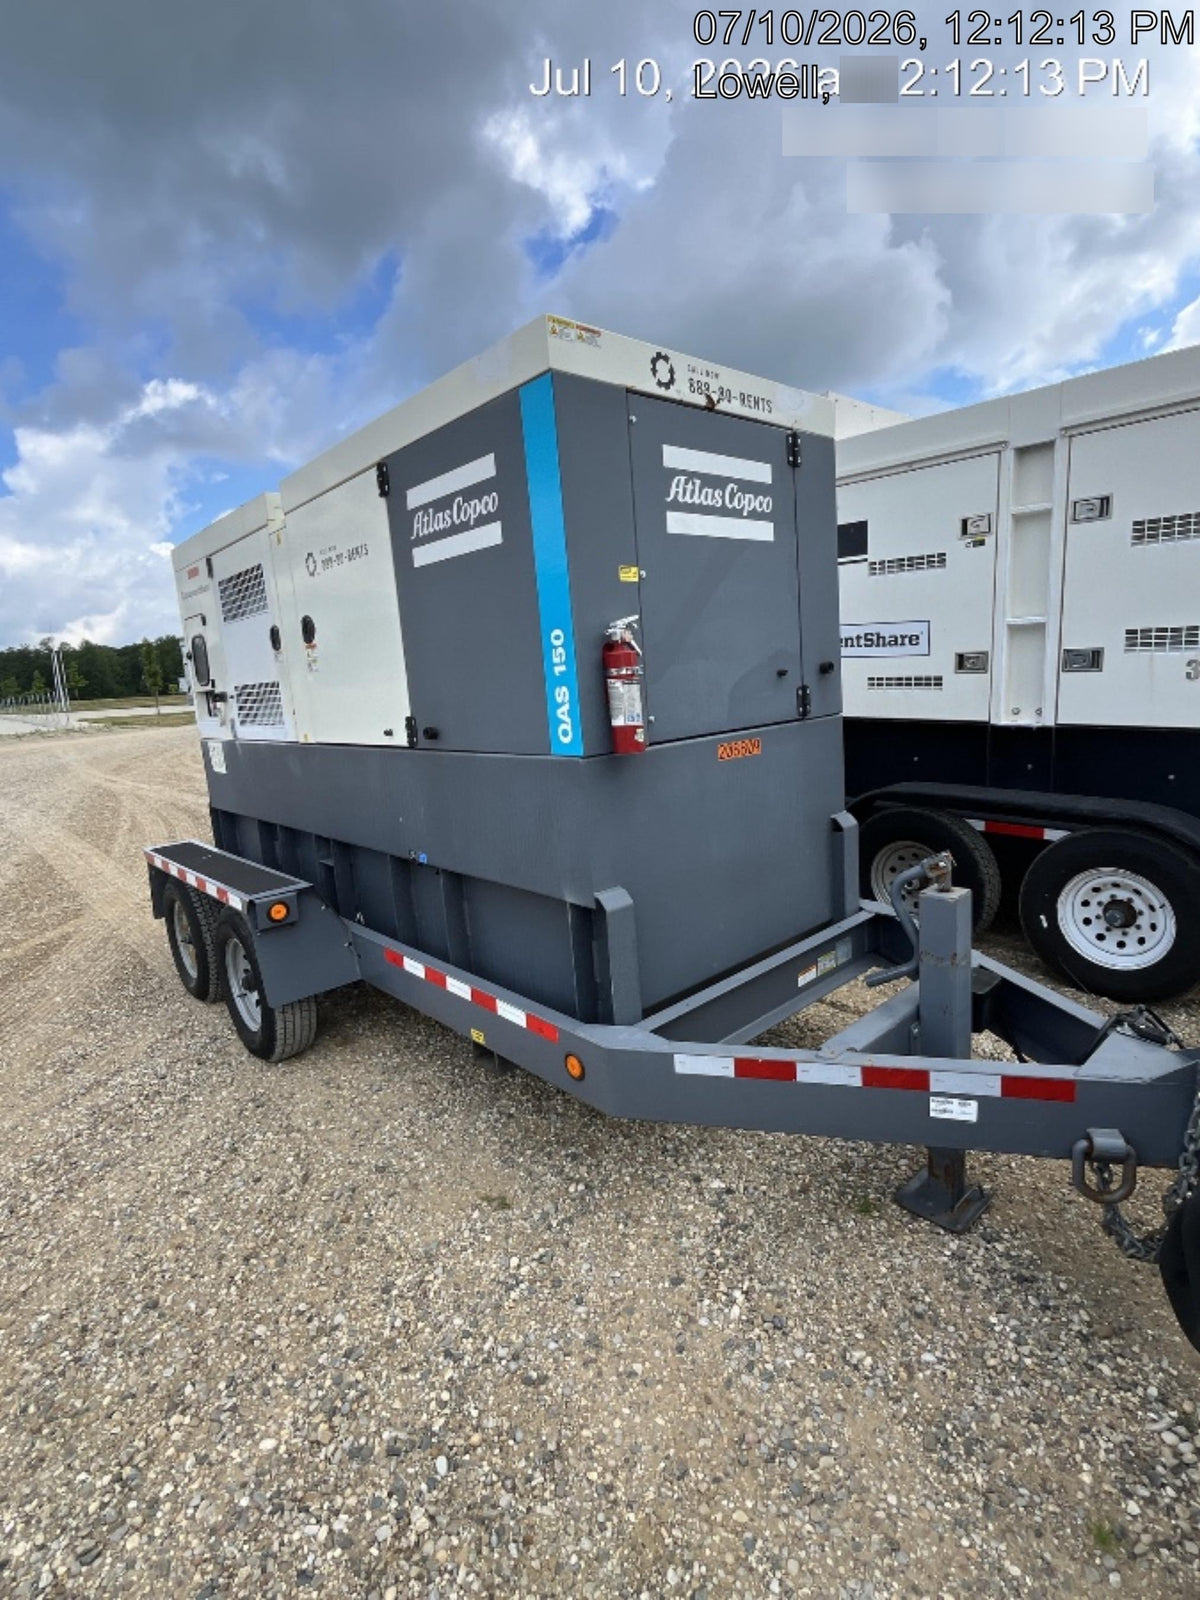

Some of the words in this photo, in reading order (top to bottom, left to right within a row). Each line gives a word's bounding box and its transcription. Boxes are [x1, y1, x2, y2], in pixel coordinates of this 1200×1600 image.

[410, 507, 452, 540] Atlas
[452, 491, 499, 526] Copco
[665, 475, 723, 508] Atlas
[725, 483, 773, 516] Copco
[550, 628, 566, 676] 150
[554, 685, 573, 744] QAS
